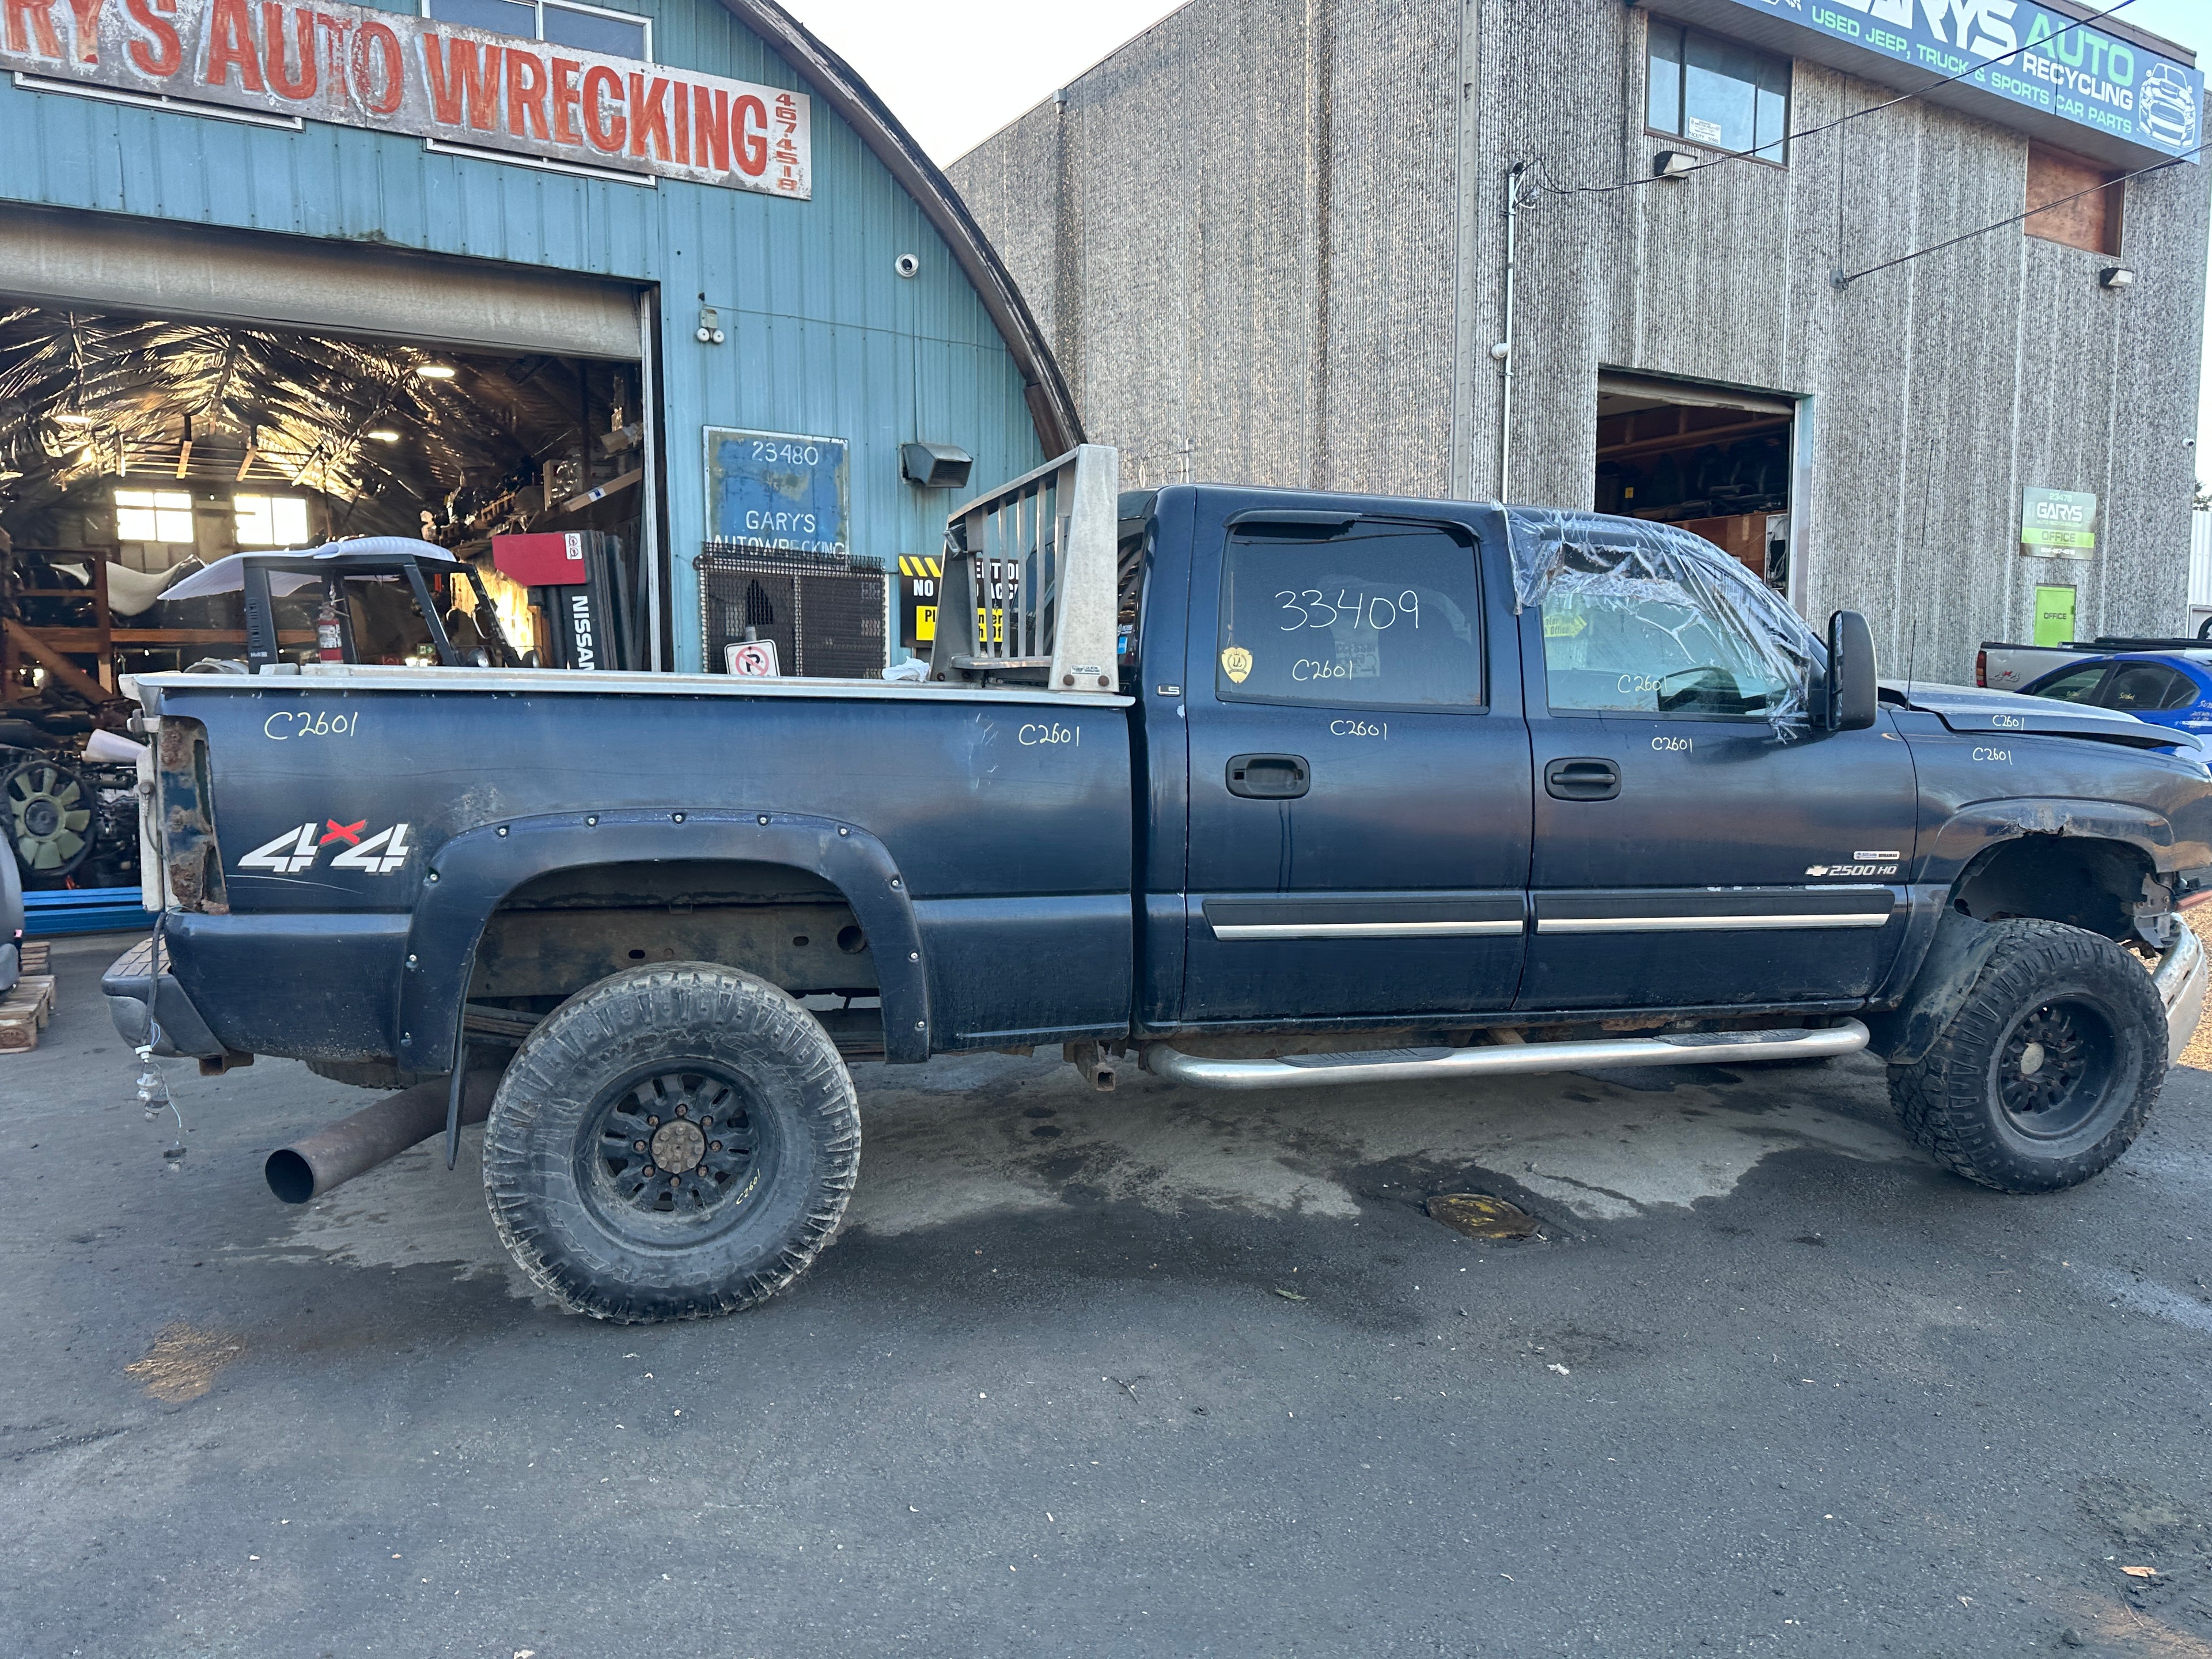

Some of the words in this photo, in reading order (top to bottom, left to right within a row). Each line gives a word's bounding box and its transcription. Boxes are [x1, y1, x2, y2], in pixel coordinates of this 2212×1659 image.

[2024, 13, 2134, 87] AUTO
[1812, 5, 1860, 37] USED
[1865, 28, 1911, 60] JEEP,
[1916, 43, 1969, 76] TRUCK
[1974, 67, 1986, 82] &
[1991, 71, 2050, 105] SPORTS
[2055, 94, 2084, 118] CAR
[2088, 107, 2133, 134] PARTS
[2022, 51, 2134, 111] RECYCLING
[198, 1, 403, 116] AUTO
[418, 32, 768, 178] WRECKING
[752, 440, 820, 466] 23480
[745, 510, 816, 533] GARY'S
[2037, 502, 2084, 522] GARYS
[2041, 531, 2075, 543] OFFICE
[913, 579, 934, 597] NO
[1275, 589, 1419, 631] 33409
[1292, 658, 1353, 681] C2601
[1158, 685, 1180, 695] LS
[1617, 674, 1668, 694] C2601
[264, 711, 358, 740] C2601
[1018, 722, 1080, 747] C2601
[1330, 719, 1387, 741] C2601
[1992, 714, 2024, 732] C2601
[1651, 737, 1693, 753] C2601
[1972, 747, 2013, 766] C2601
[1828, 865, 1876, 876] 2500
[1877, 866, 1897, 874] HD
[736, 1168, 761, 1205] C2601
